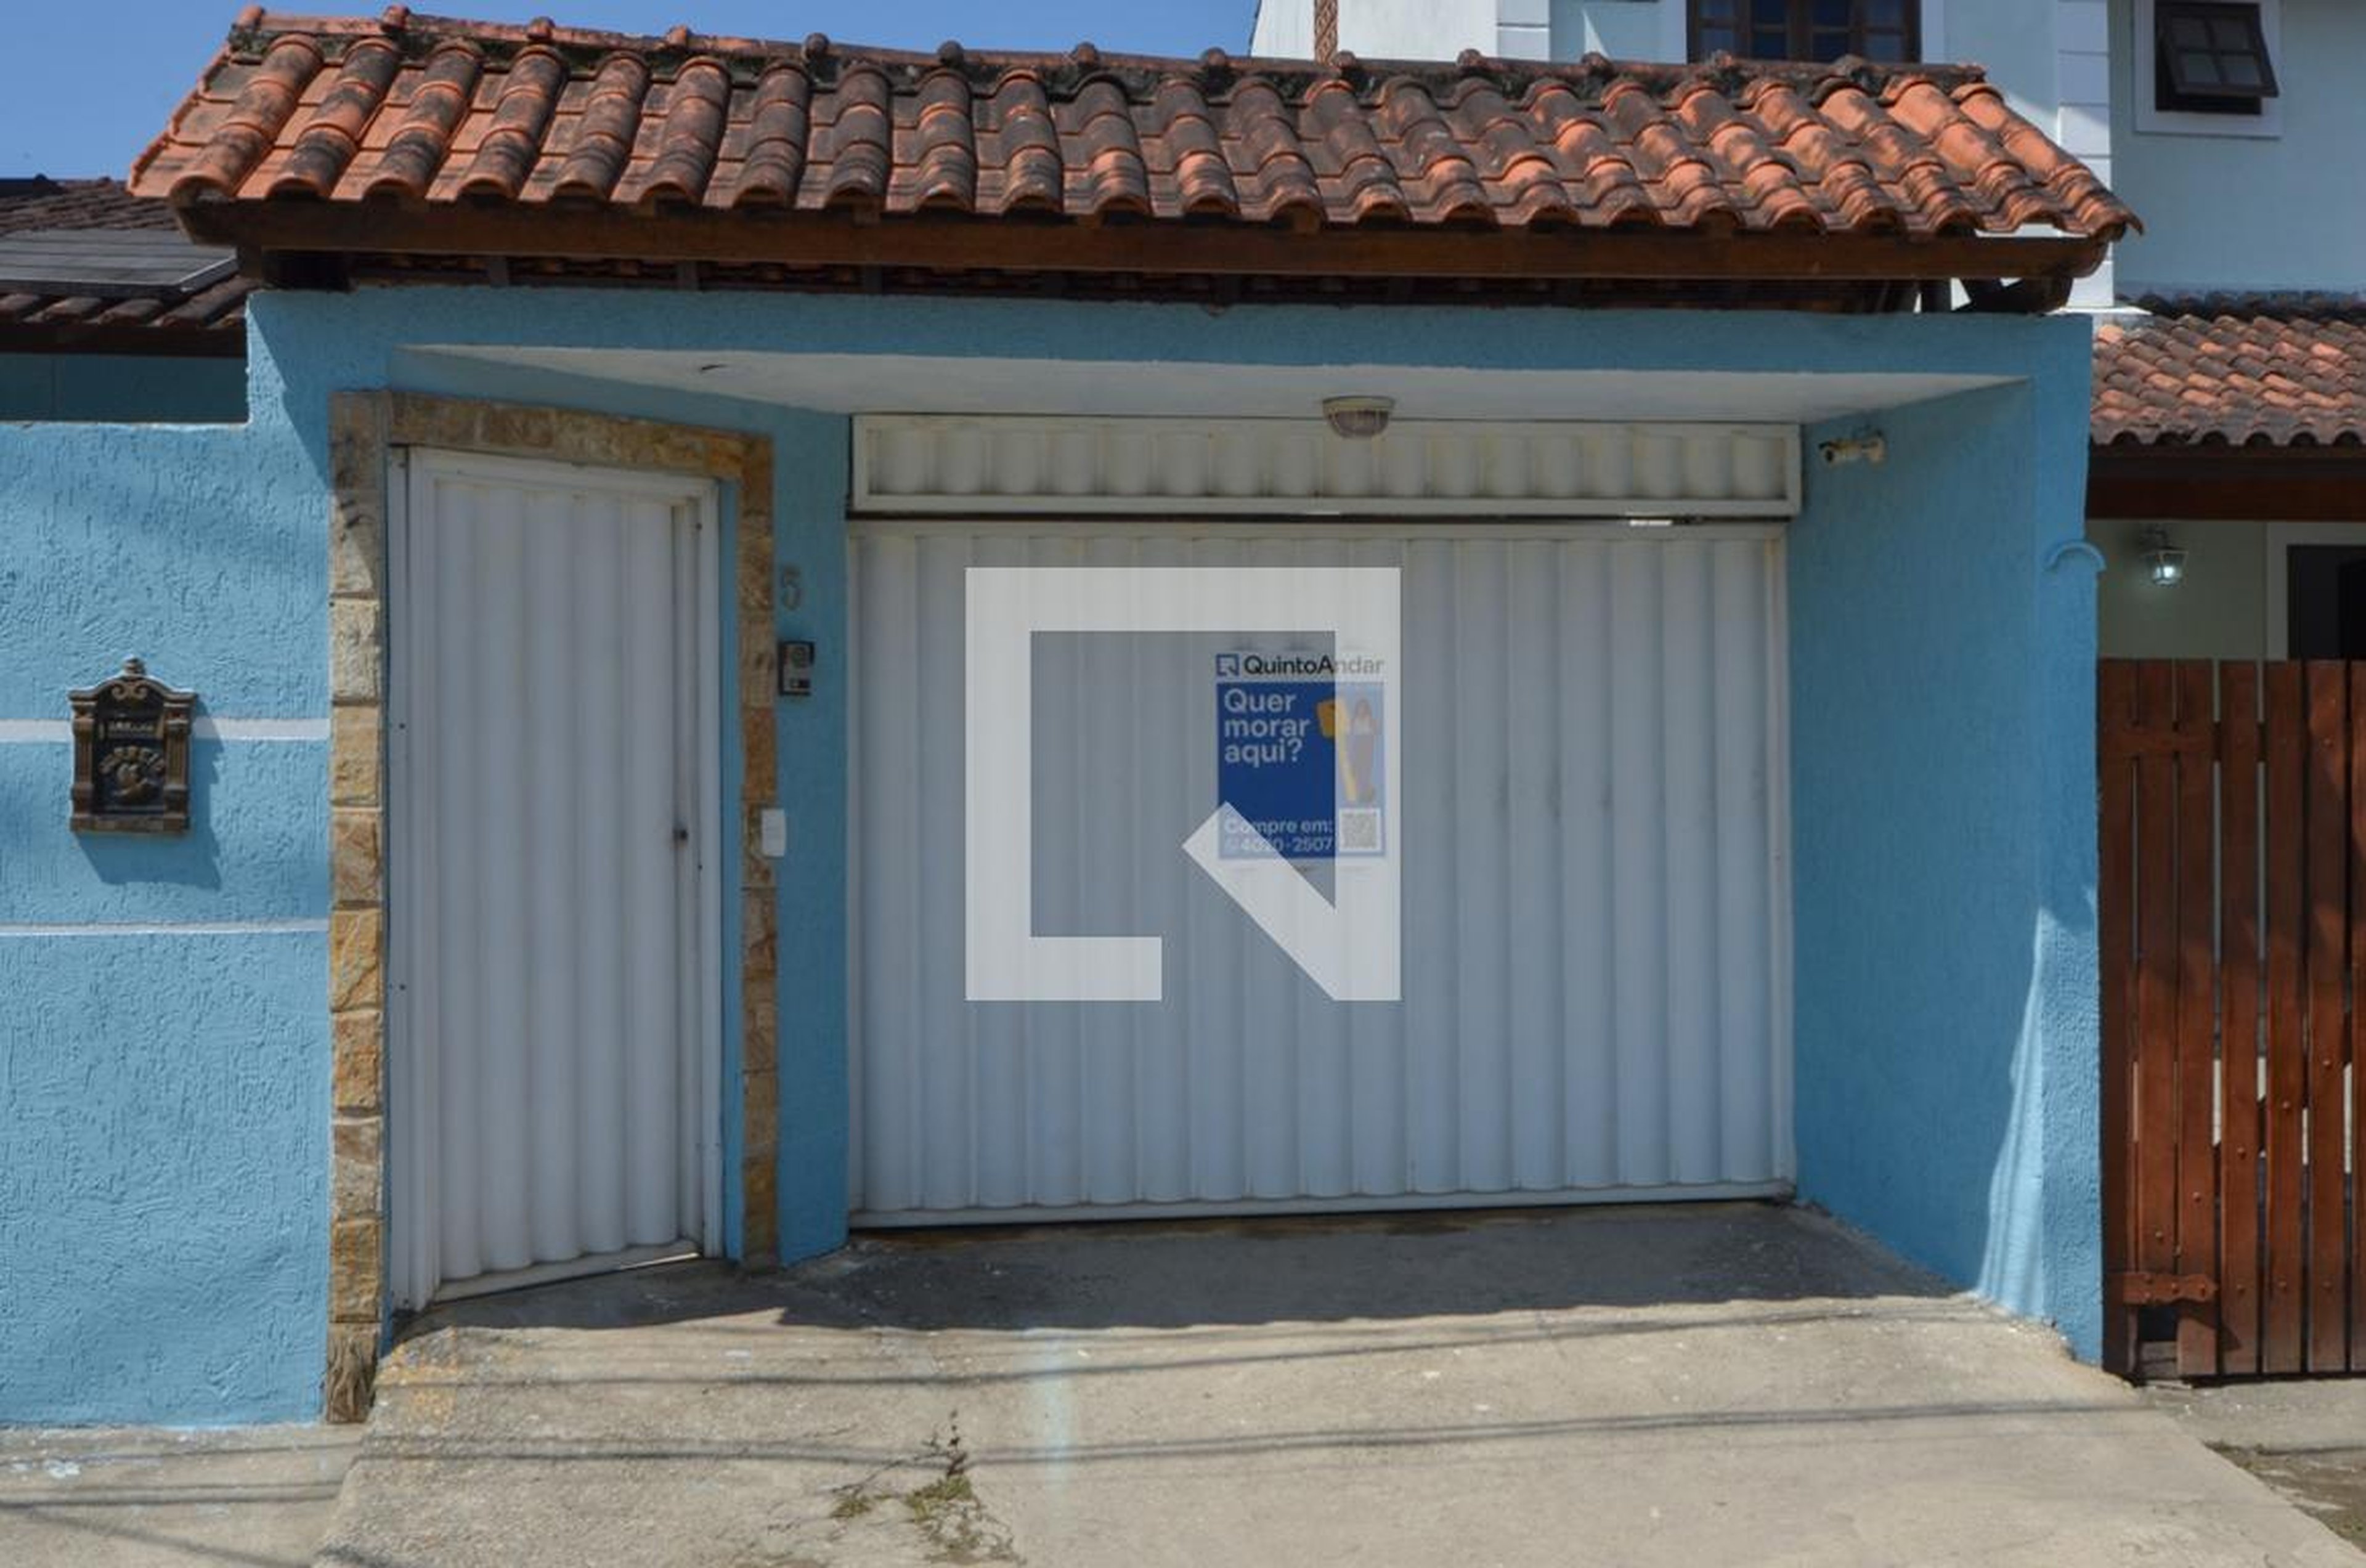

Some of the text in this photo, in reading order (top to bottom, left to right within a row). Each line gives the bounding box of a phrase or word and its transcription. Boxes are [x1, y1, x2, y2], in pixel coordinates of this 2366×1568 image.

[1244, 655, 1384, 675] QuintoAndar
[1224, 688, 1296, 713] Quer
[1224, 718, 1311, 737] morar
[1224, 738, 1303, 768] aqui?
[1224, 819, 1333, 835] Compre em:
